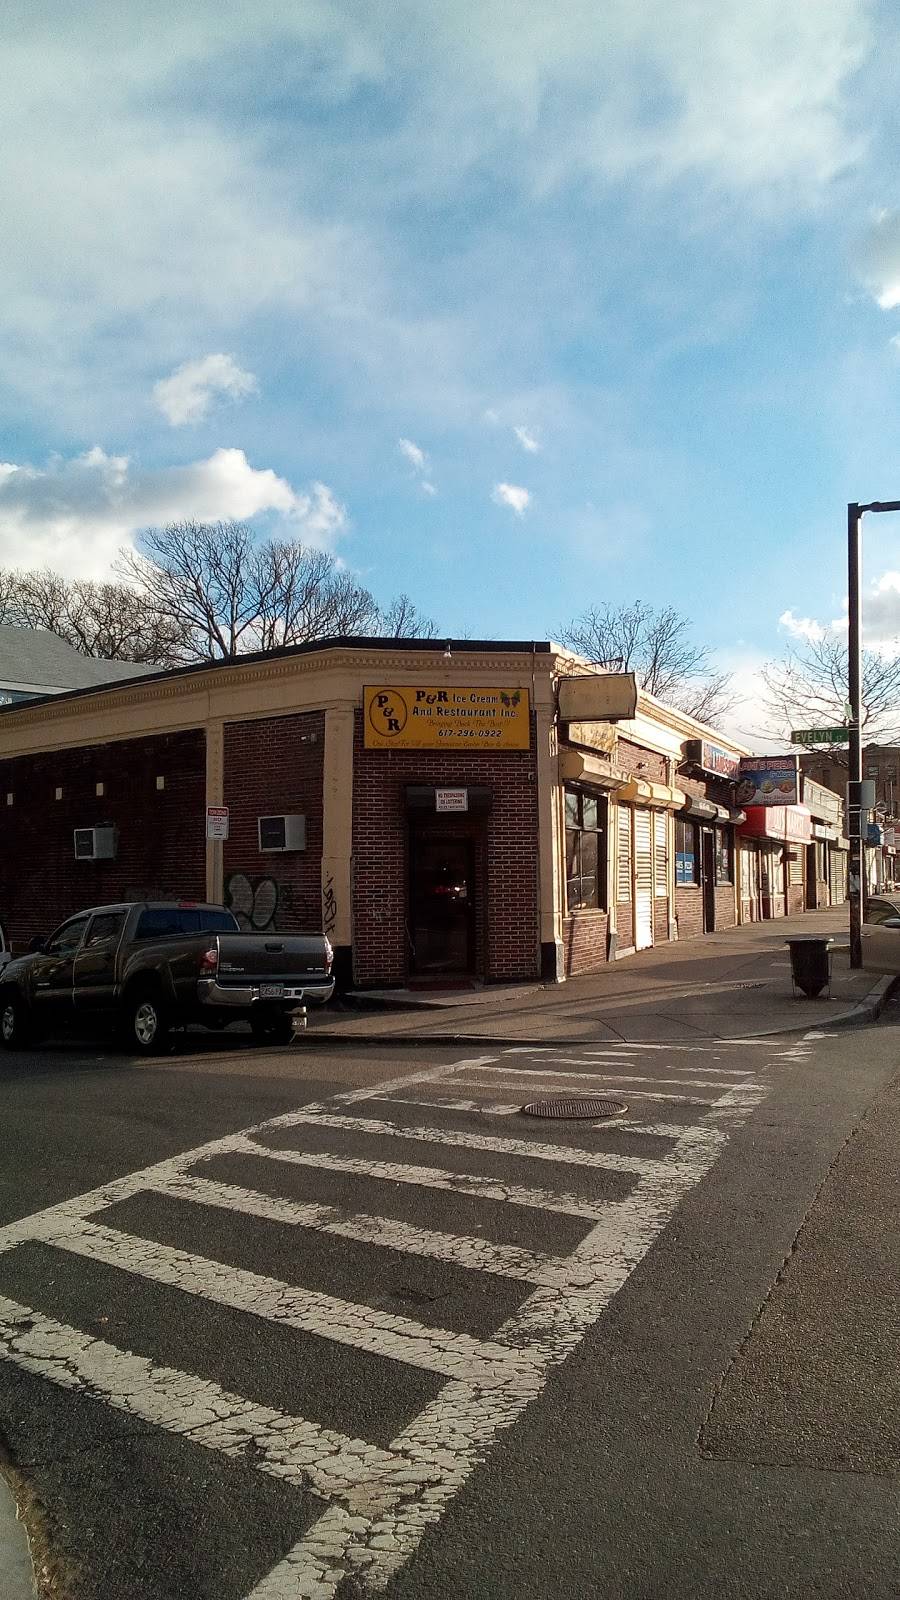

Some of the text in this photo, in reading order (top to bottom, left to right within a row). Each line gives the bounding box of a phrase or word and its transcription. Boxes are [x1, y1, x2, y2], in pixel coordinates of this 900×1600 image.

[377, 695, 389, 707] P
[416, 690, 498, 704] P&R Ice Cream
[383, 707, 394, 717] &
[413, 706, 432, 716] And
[436, 706, 496, 717] Restaurant
[388, 718, 401, 731] R
[438, 729, 503, 738] 617-296-0922
[795, 731, 833, 743] EVELYN
[767, 760, 794, 770] PIZZA
